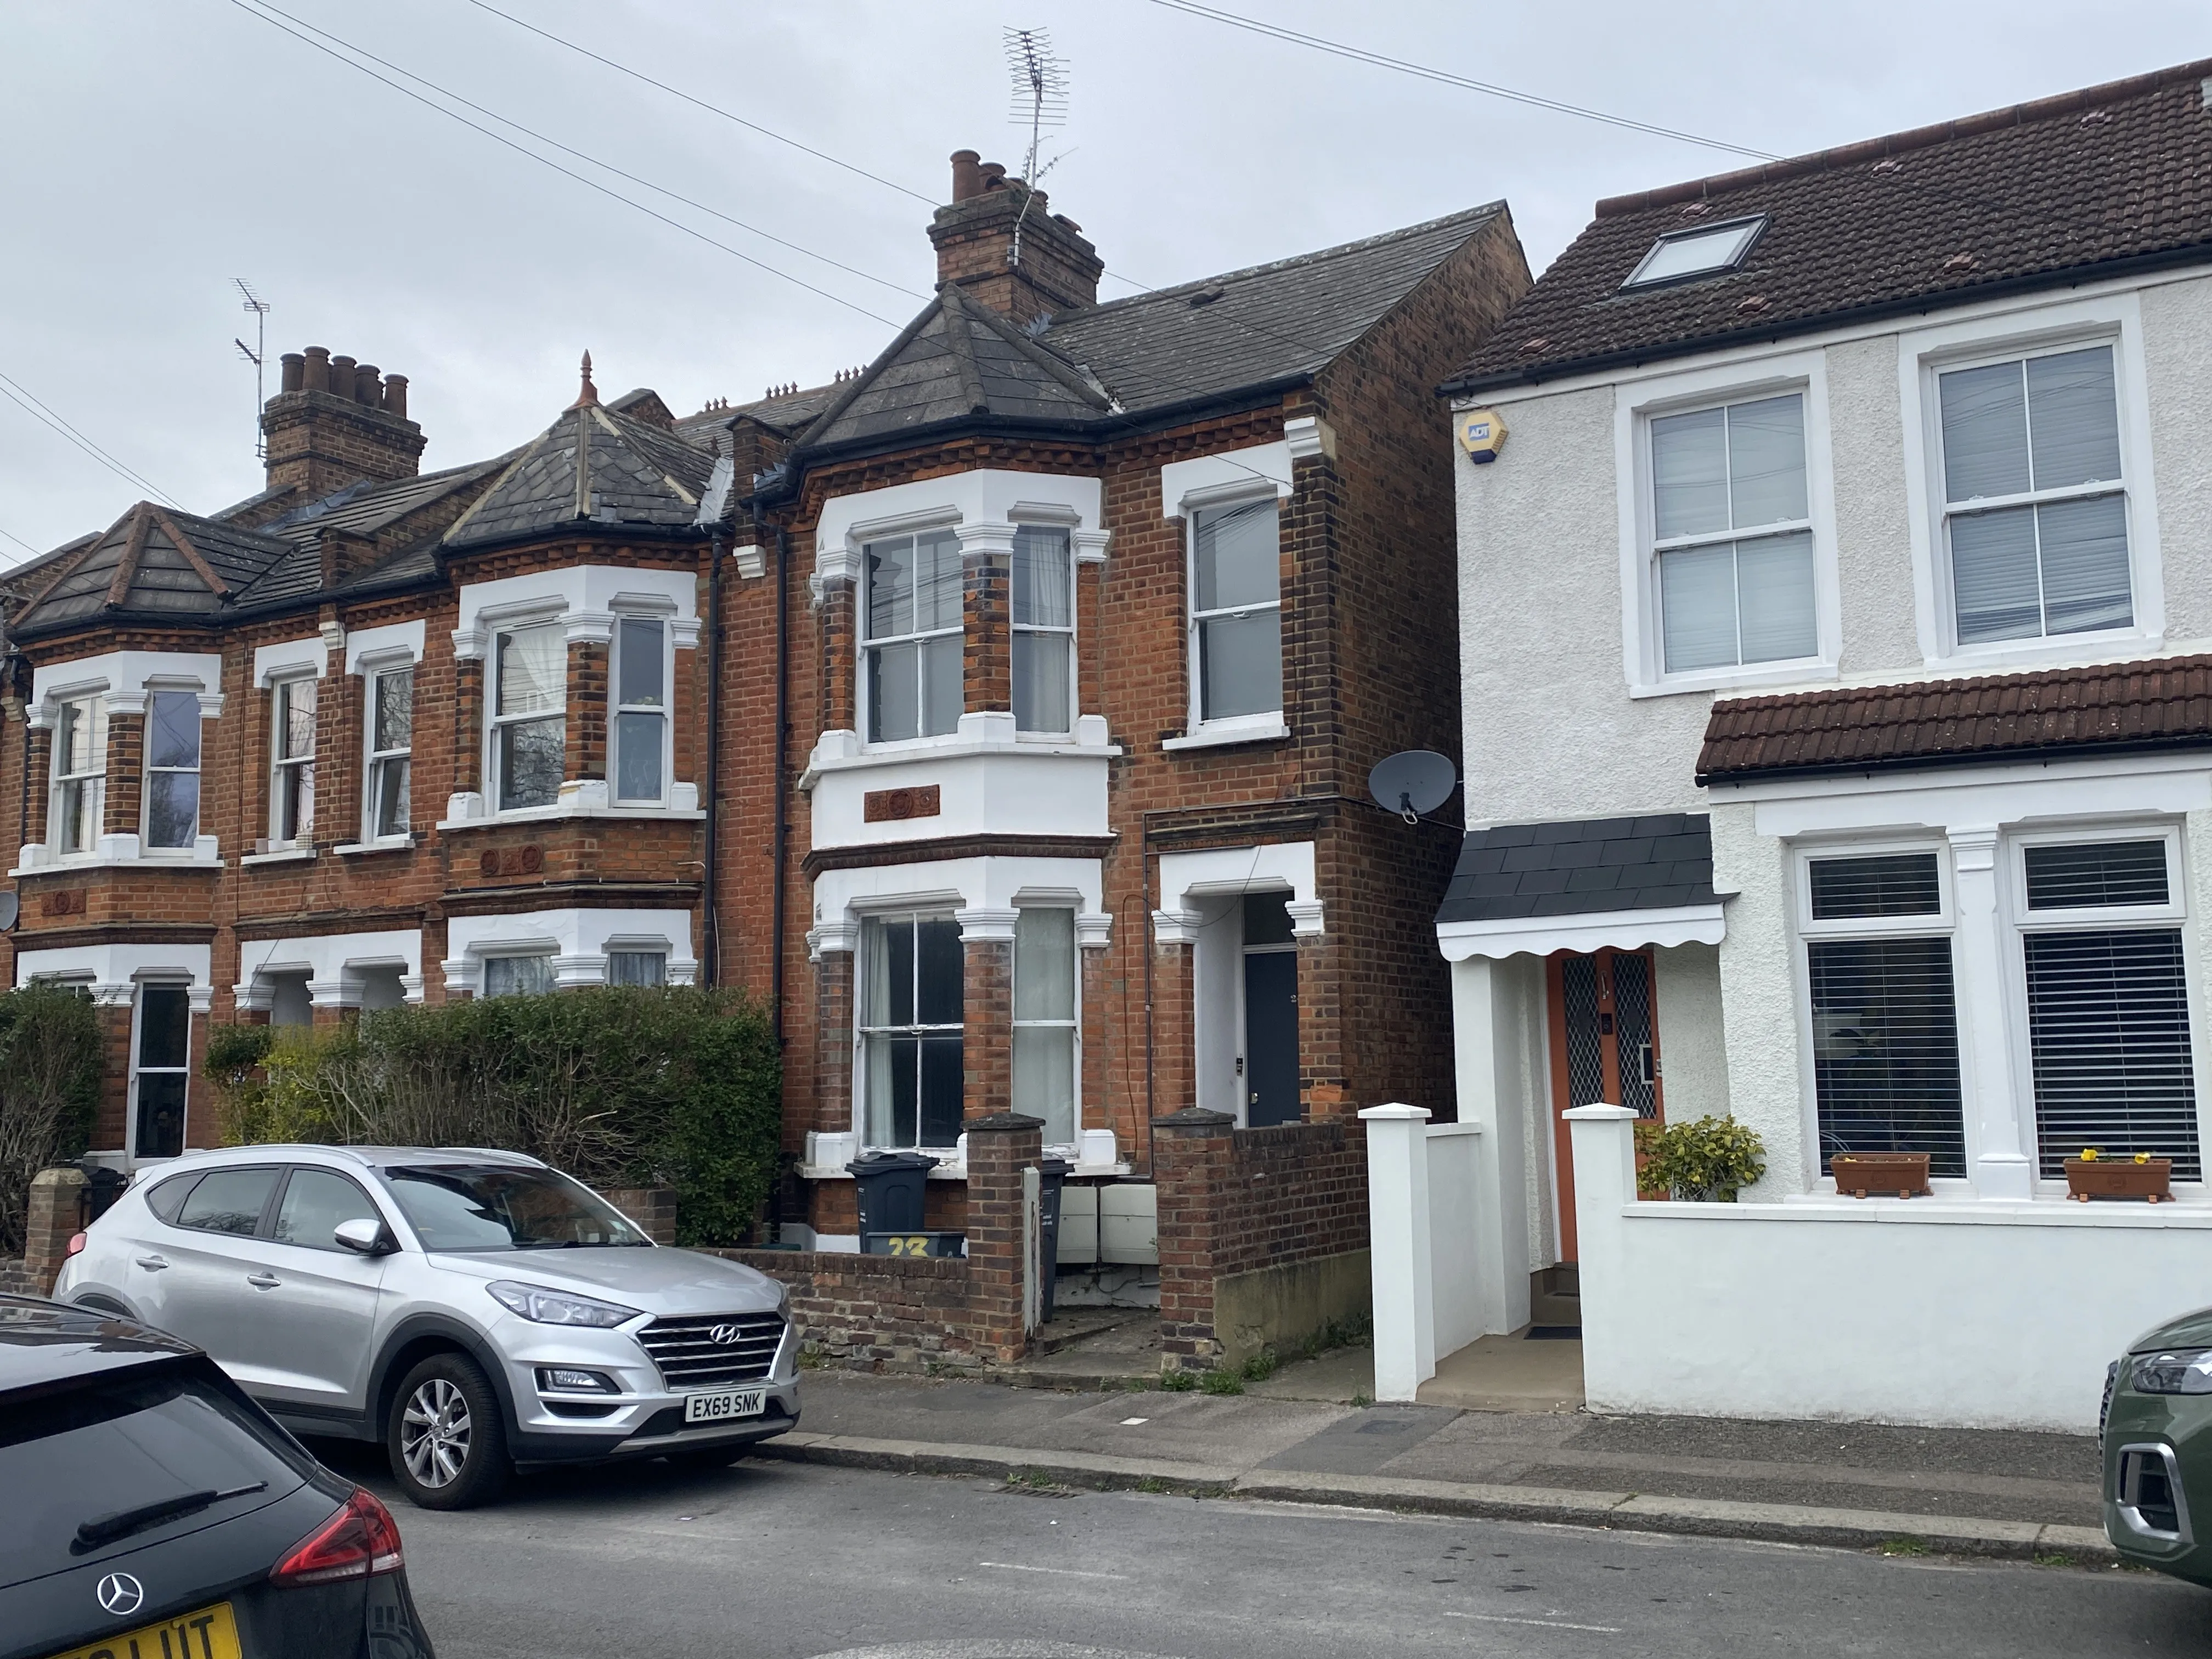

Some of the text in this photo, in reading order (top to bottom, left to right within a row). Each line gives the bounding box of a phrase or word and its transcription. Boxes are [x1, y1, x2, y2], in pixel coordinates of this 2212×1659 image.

[1470, 425, 1490, 438] ADT
[693, 1392, 760, 1418] EX69 SNK
